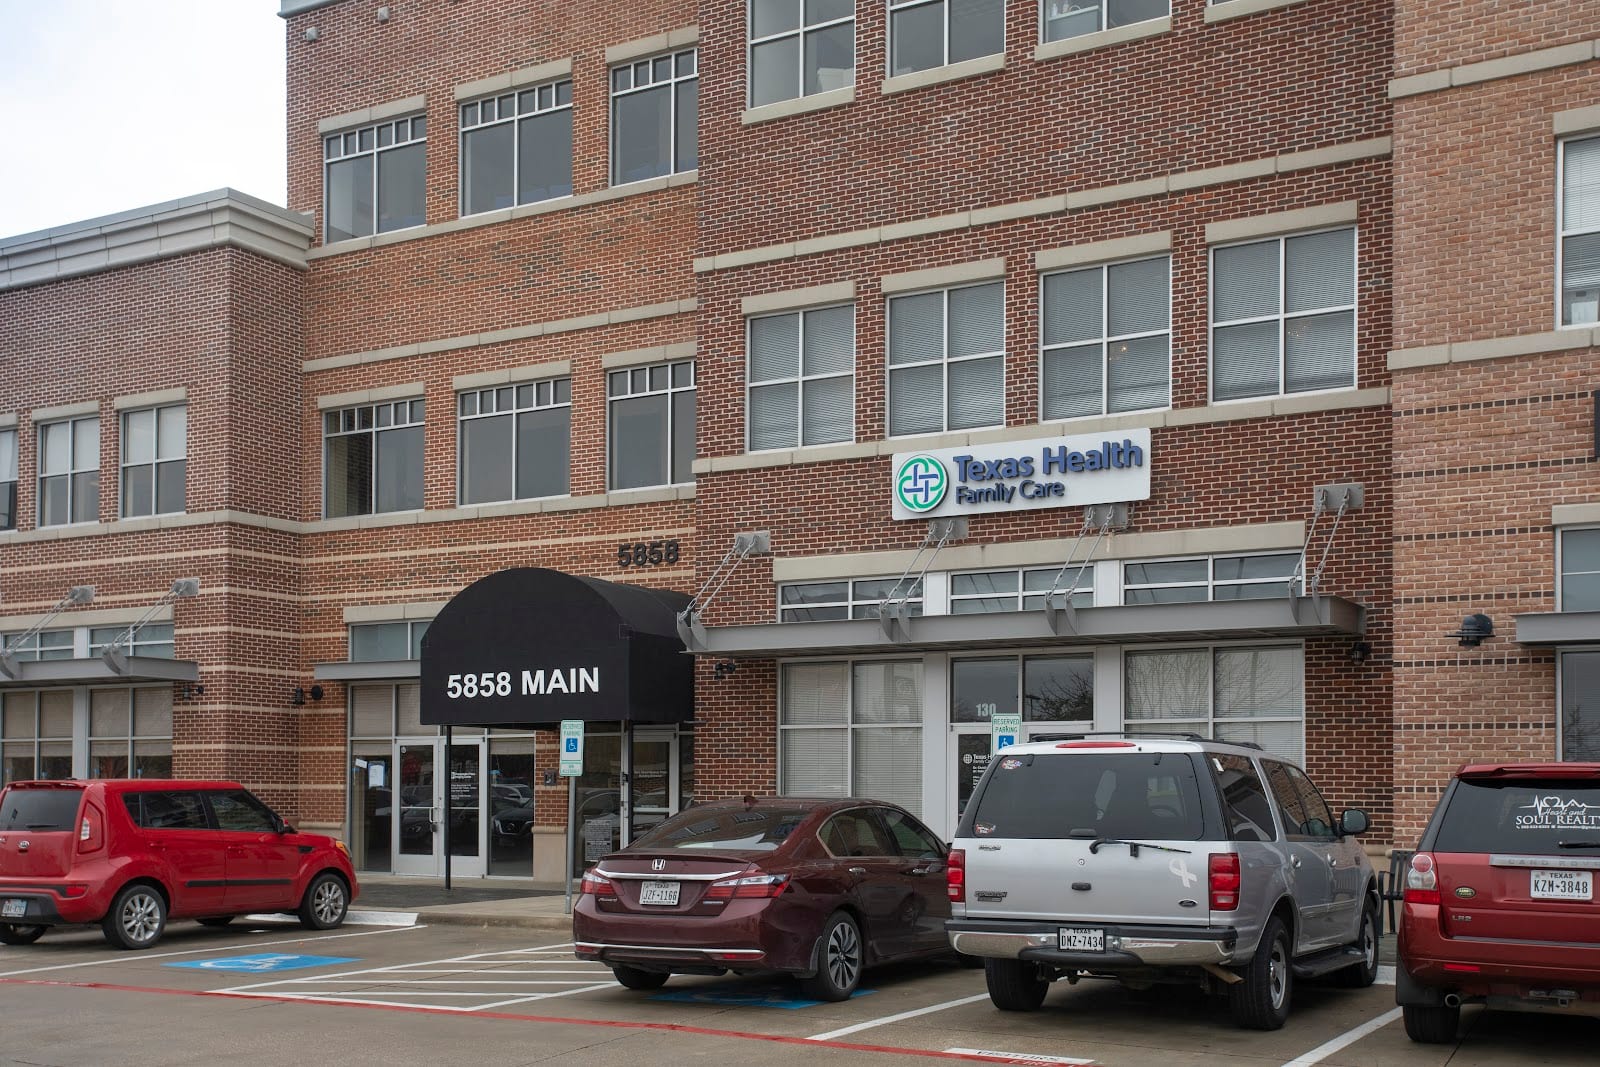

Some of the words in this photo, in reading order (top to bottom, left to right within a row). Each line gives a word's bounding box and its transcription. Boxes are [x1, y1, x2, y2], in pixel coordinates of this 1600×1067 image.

[953, 454, 1034, 483] Texas
[1042, 439, 1143, 475] Health
[955, 482, 1016, 505] Family
[1019, 480, 1065, 500] Care
[617, 539, 680, 567] 5858
[447, 672, 512, 699] 5858
[521, 667, 599, 696] MAIN
[976, 703, 996, 717] 130
[1515, 815, 1552, 825] SOUL
[1556, 815, 1600, 825] REALT
